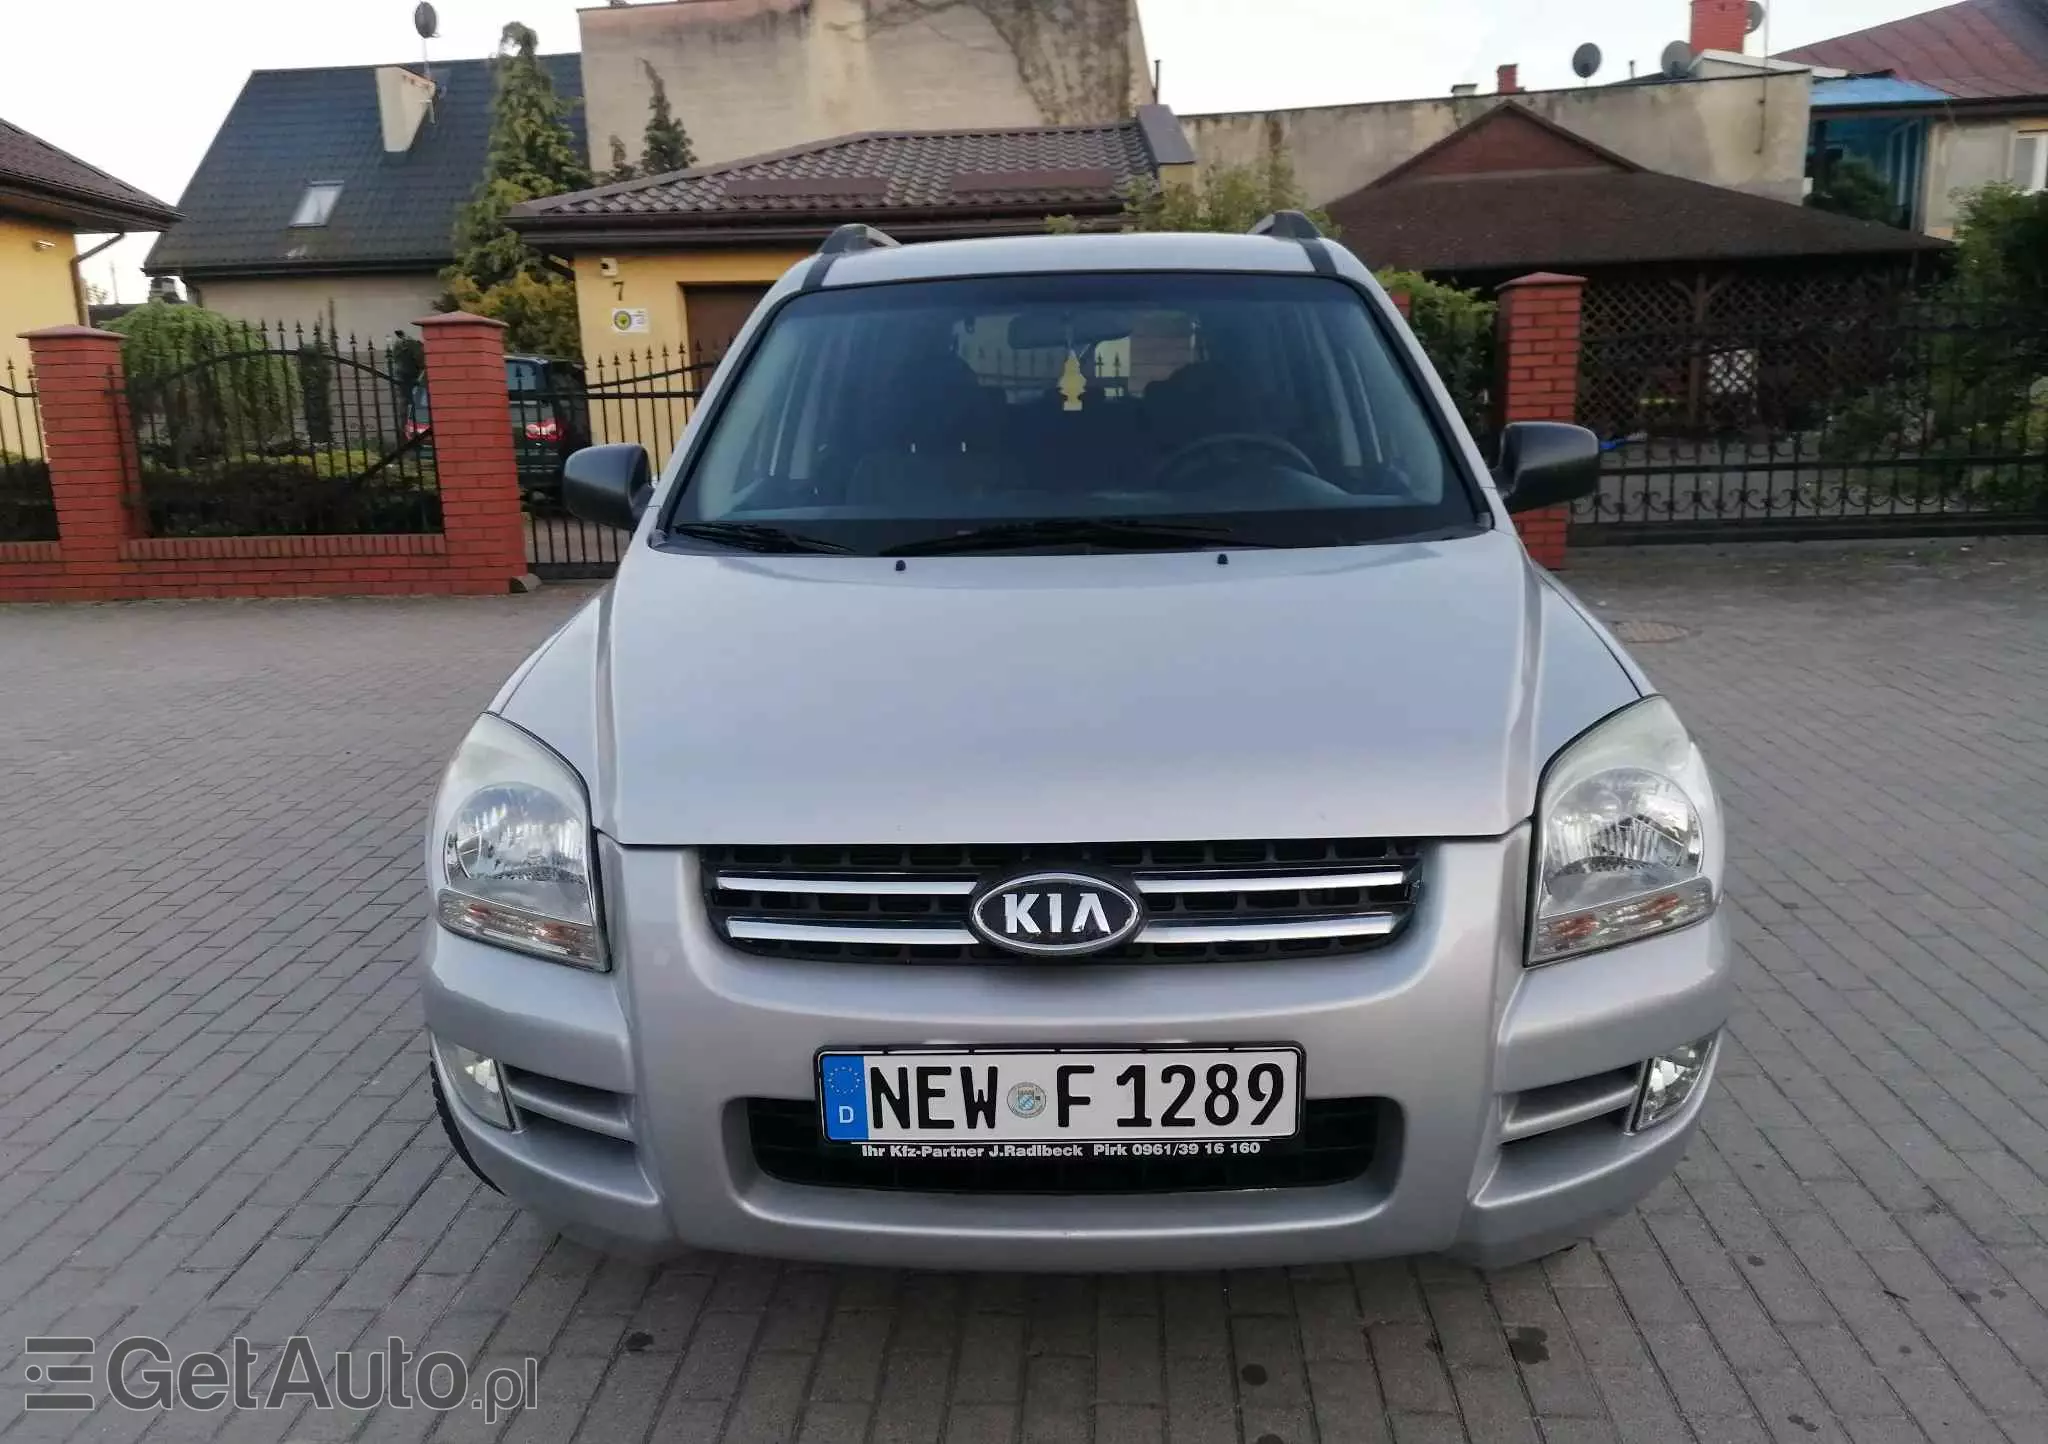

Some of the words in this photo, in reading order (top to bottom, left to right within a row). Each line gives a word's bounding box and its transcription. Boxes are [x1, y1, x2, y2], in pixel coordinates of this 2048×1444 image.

[612, 280, 625, 301] 7
[1002, 893, 1112, 935] KIA
[870, 1065, 998, 1129] NEW
[1056, 1065, 1095, 1127] F
[1116, 1063, 1284, 1127] 1289
[838, 1106, 854, 1123] D
[861, 1145, 886, 1157] Ihr
[890, 1145, 984, 1158] Kfz-Partner
[1093, 1143, 1128, 1156] Pirk
[1132, 1143, 1199, 1156] 0961/39
[1204, 1142, 1225, 1154] 16
[1230, 1142, 1261, 1154] 160
